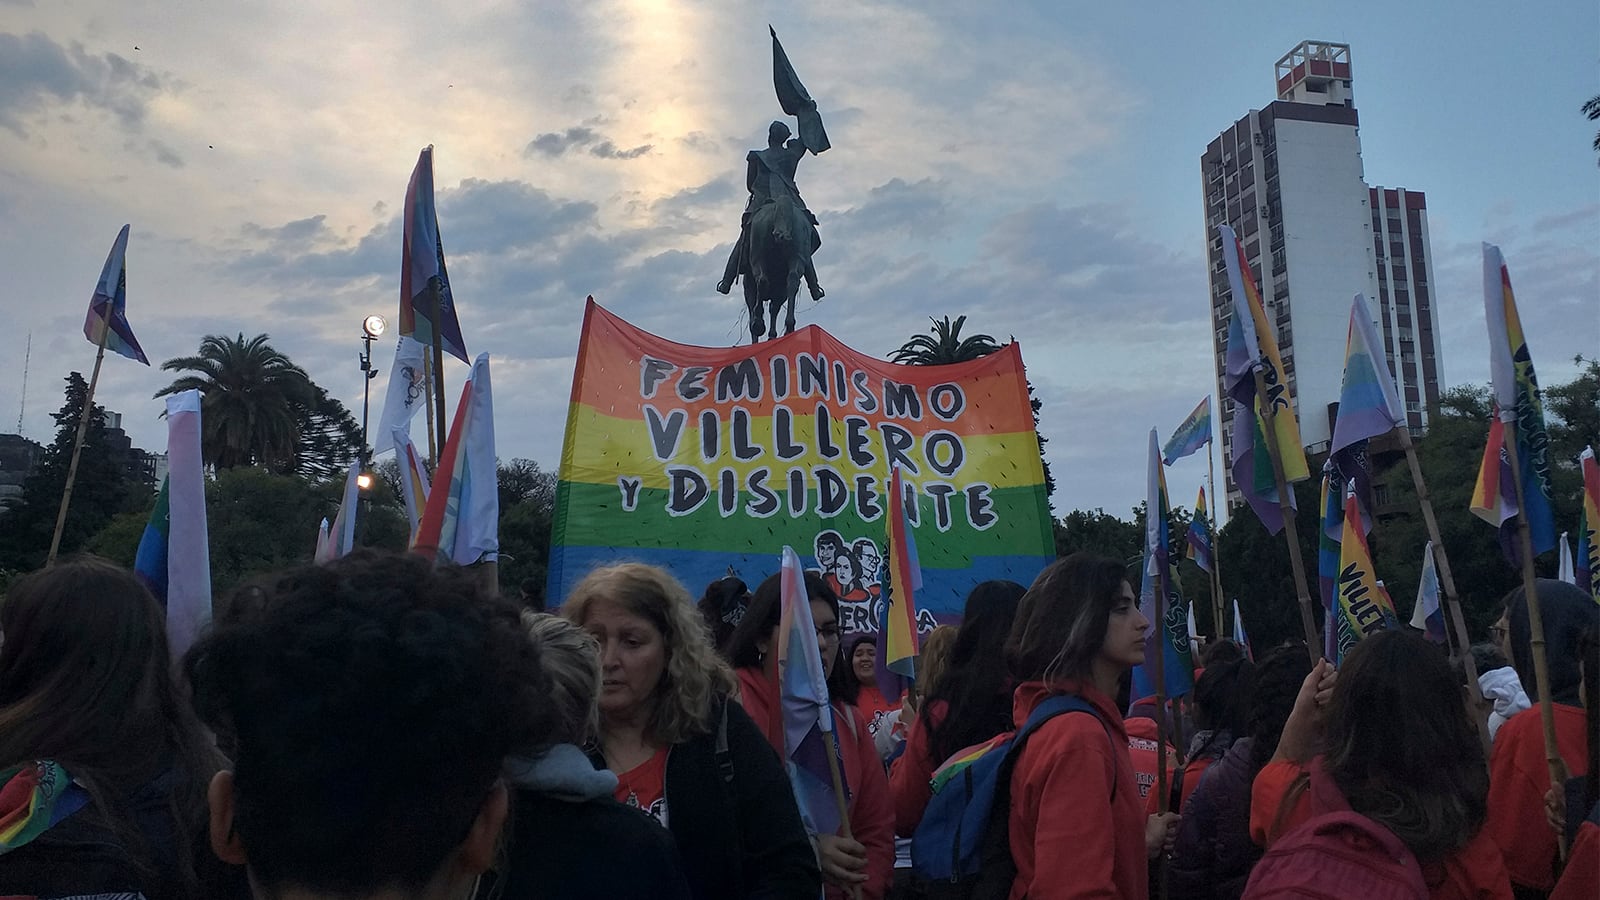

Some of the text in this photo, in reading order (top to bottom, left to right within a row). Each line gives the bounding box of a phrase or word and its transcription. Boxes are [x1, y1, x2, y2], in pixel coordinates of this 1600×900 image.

[642, 353, 965, 421] FEMINISMO
[643, 402, 964, 477] VILLLERO
[618, 477, 641, 511] Y
